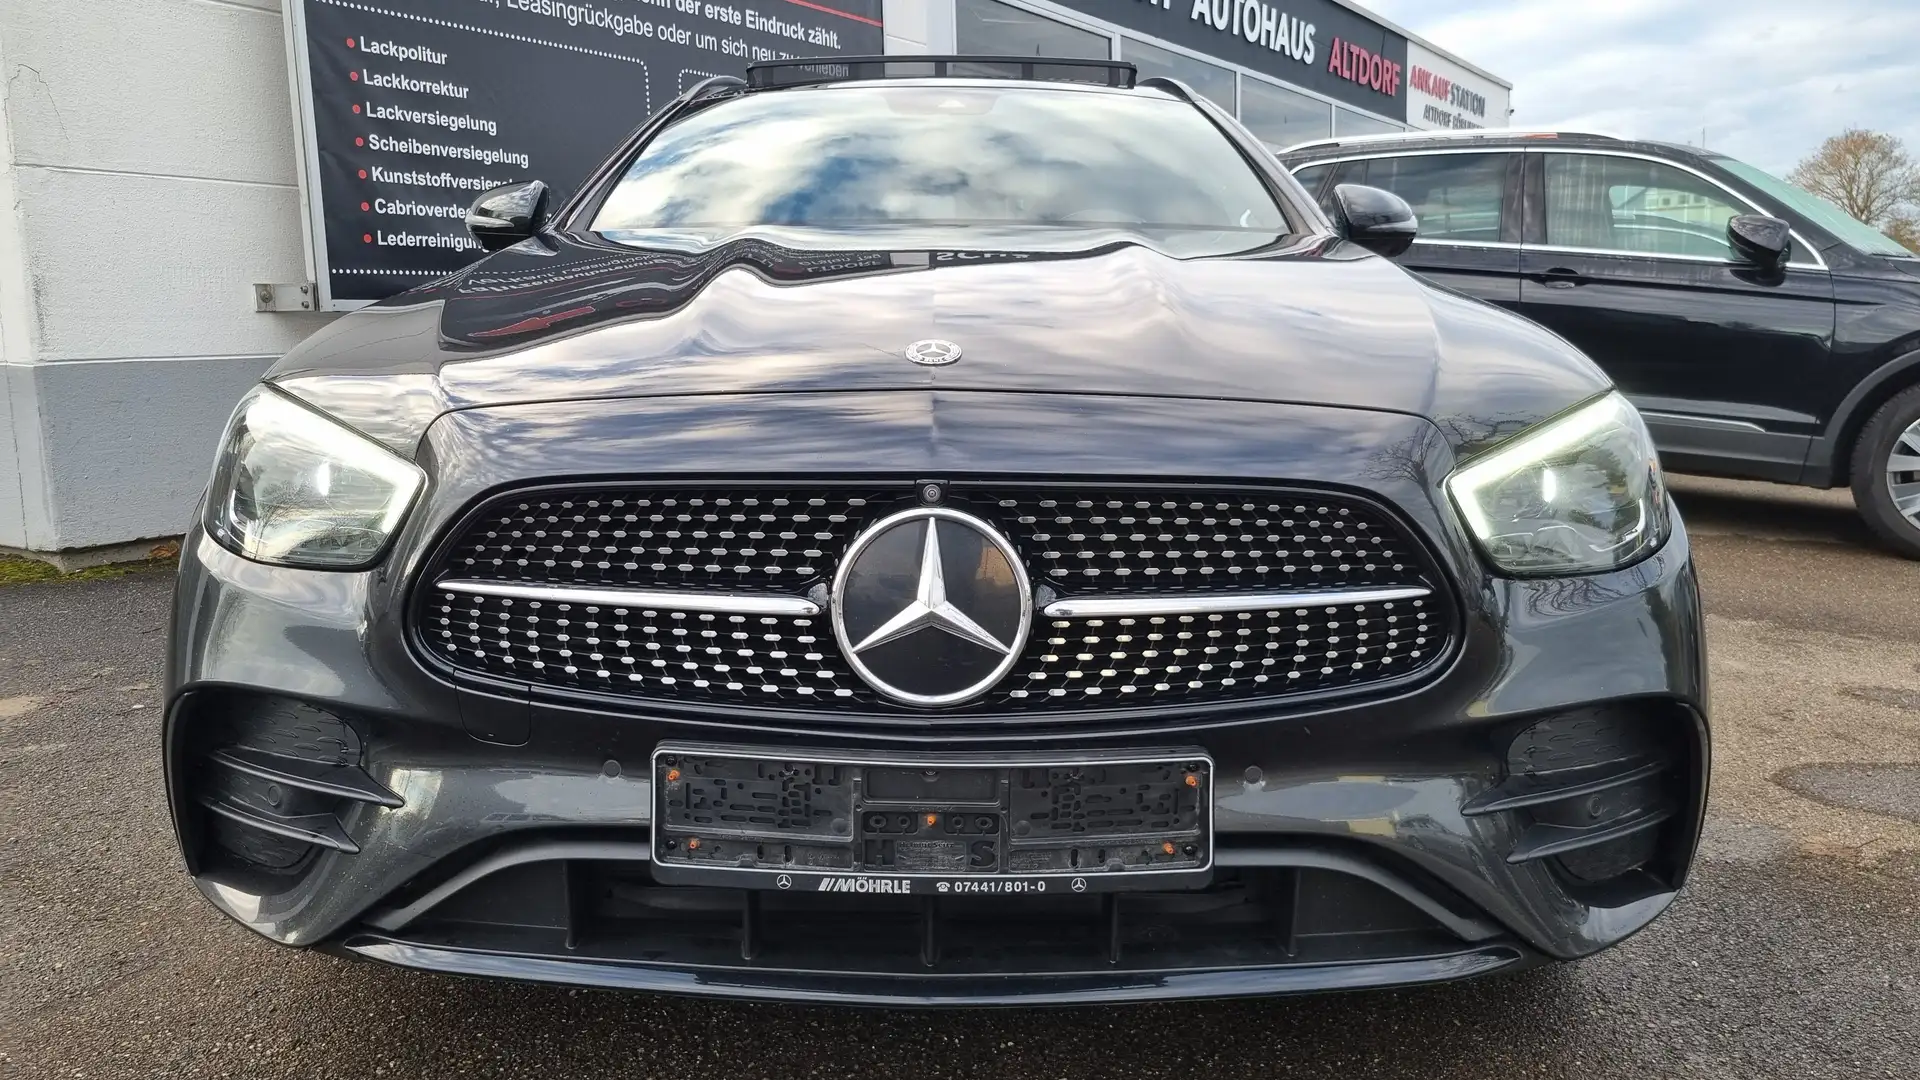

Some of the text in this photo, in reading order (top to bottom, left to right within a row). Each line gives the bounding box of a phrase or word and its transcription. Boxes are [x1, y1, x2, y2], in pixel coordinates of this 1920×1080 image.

[675, 0, 701, 15] der
[705, 5, 742, 26] erste
[745, 9, 806, 41] Eindruck
[807, 27, 842, 50] zählt.
[359, 35, 448, 65] Lackpolitur
[657, 23, 692, 46] oder
[695, 31, 718, 52] um
[721, 37, 749, 59] sich
[752, 46, 776, 62] neu
[1190, 0, 1402, 97] AUTOHAUS ALTDORF
[362, 68, 469, 99] Lackkorrektur
[365, 101, 498, 136] Lackversiegelung
[1422, 103, 1453, 128] ALTDORF
[368, 133, 530, 169] Scheibenversiegelung
[371, 165, 513, 191] Kunststoffversie
[377, 229, 489, 253] Lederreinigu
[832, 876, 1046, 894] MÖHRLE 07441/801-0
